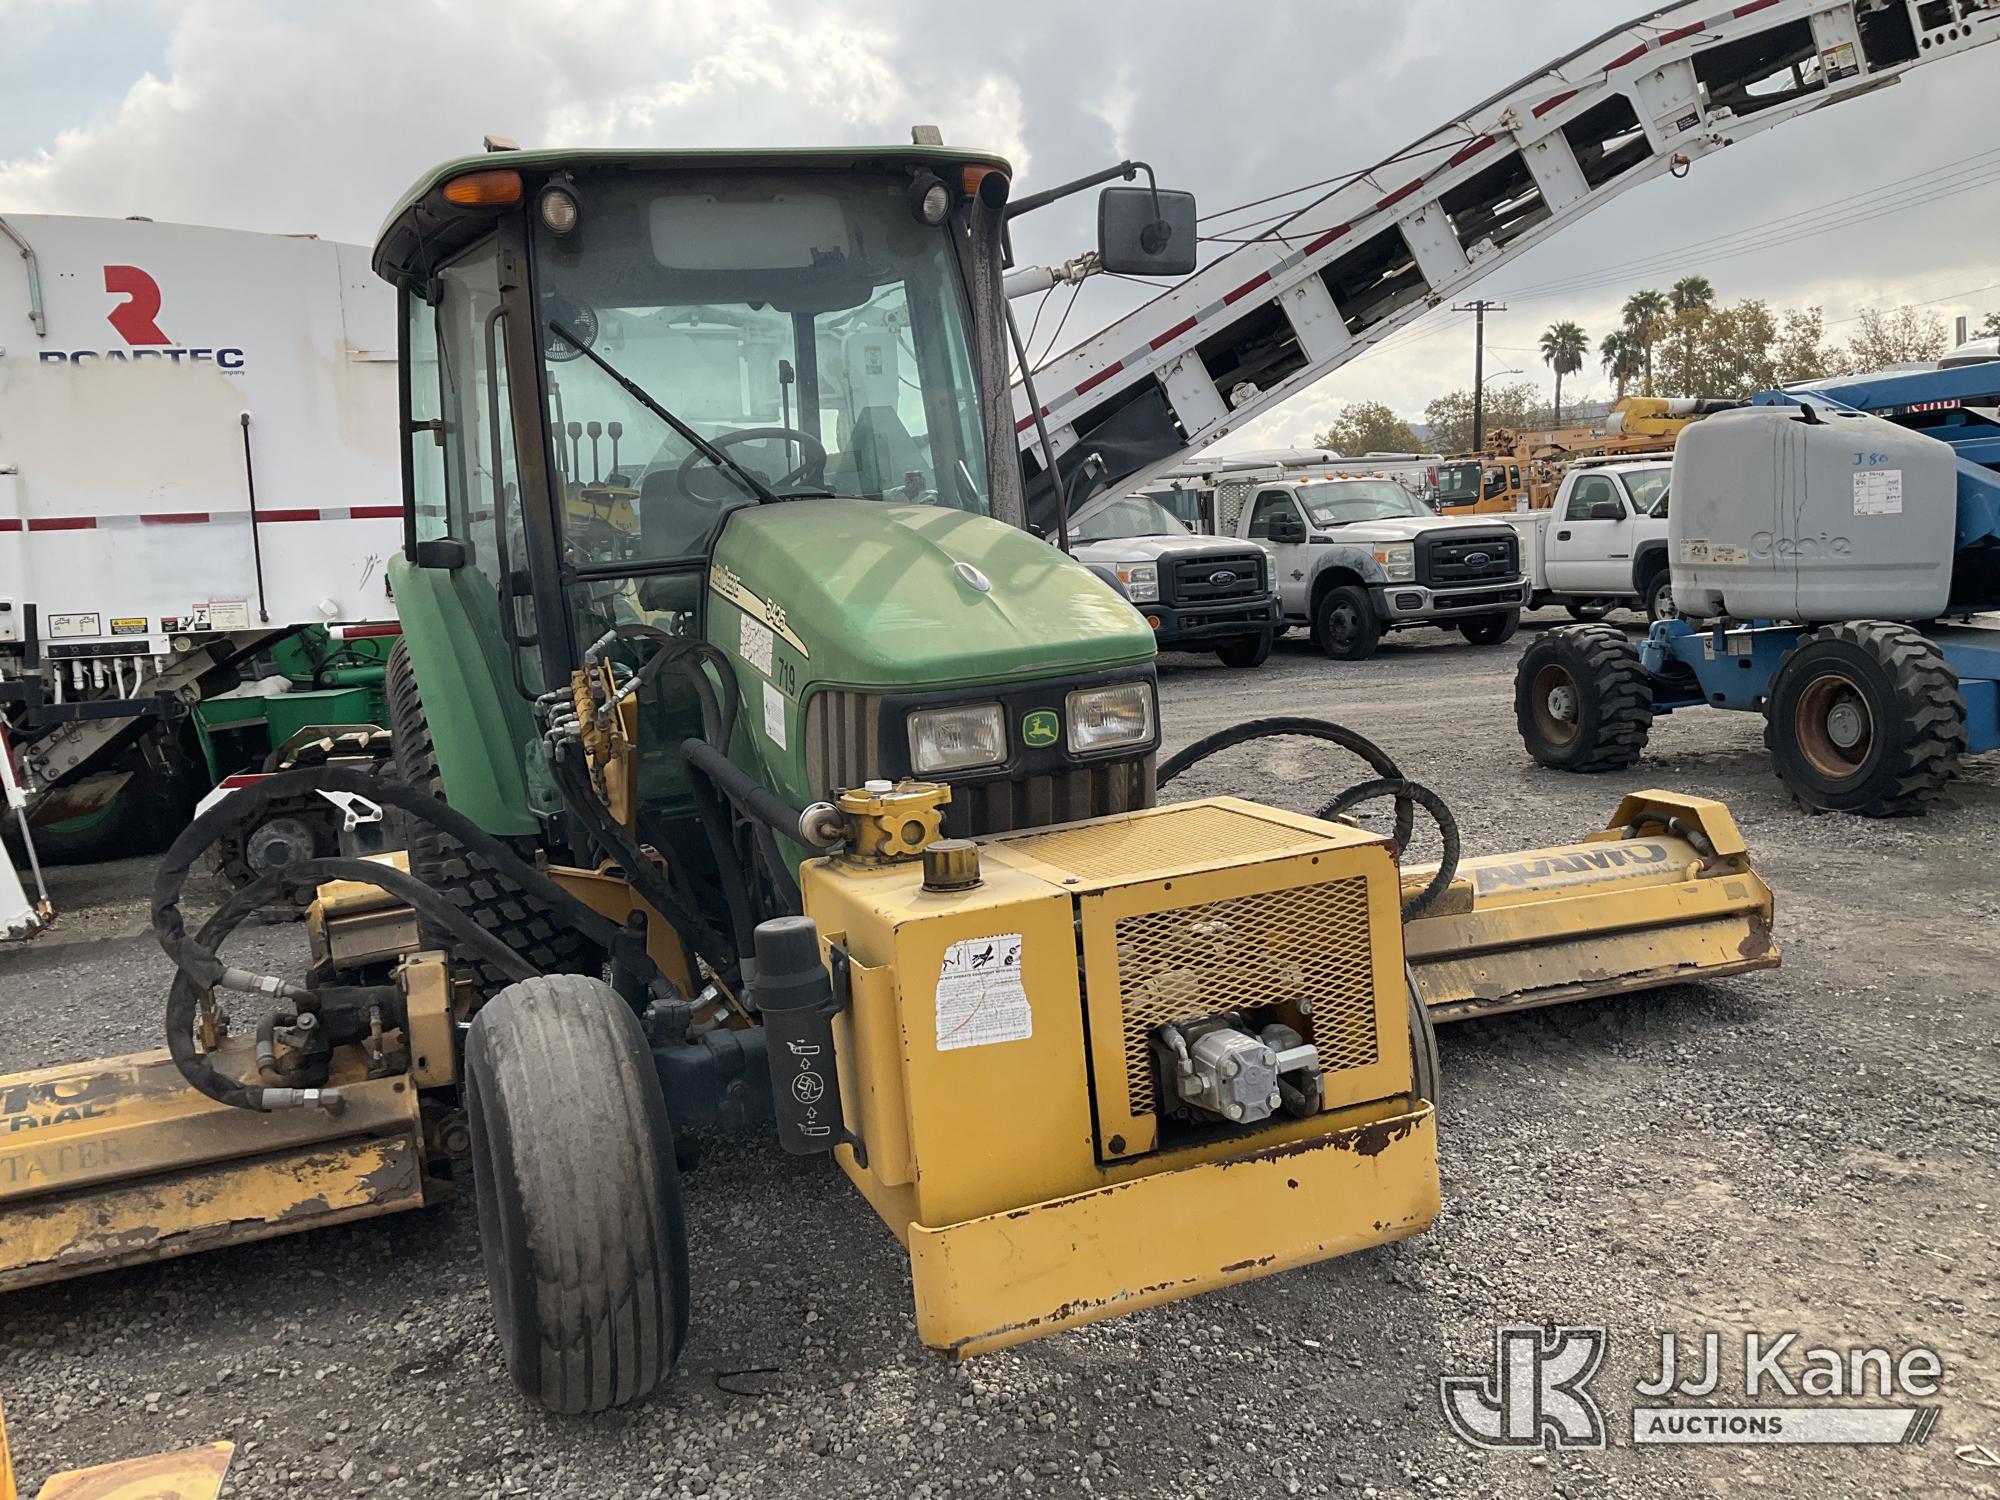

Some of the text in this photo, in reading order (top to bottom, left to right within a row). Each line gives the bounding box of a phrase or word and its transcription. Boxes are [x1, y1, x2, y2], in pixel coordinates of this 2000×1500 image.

[1851, 452, 1865, 466] J
[765, 597, 786, 632] 5425
[778, 657, 796, 697] 719
